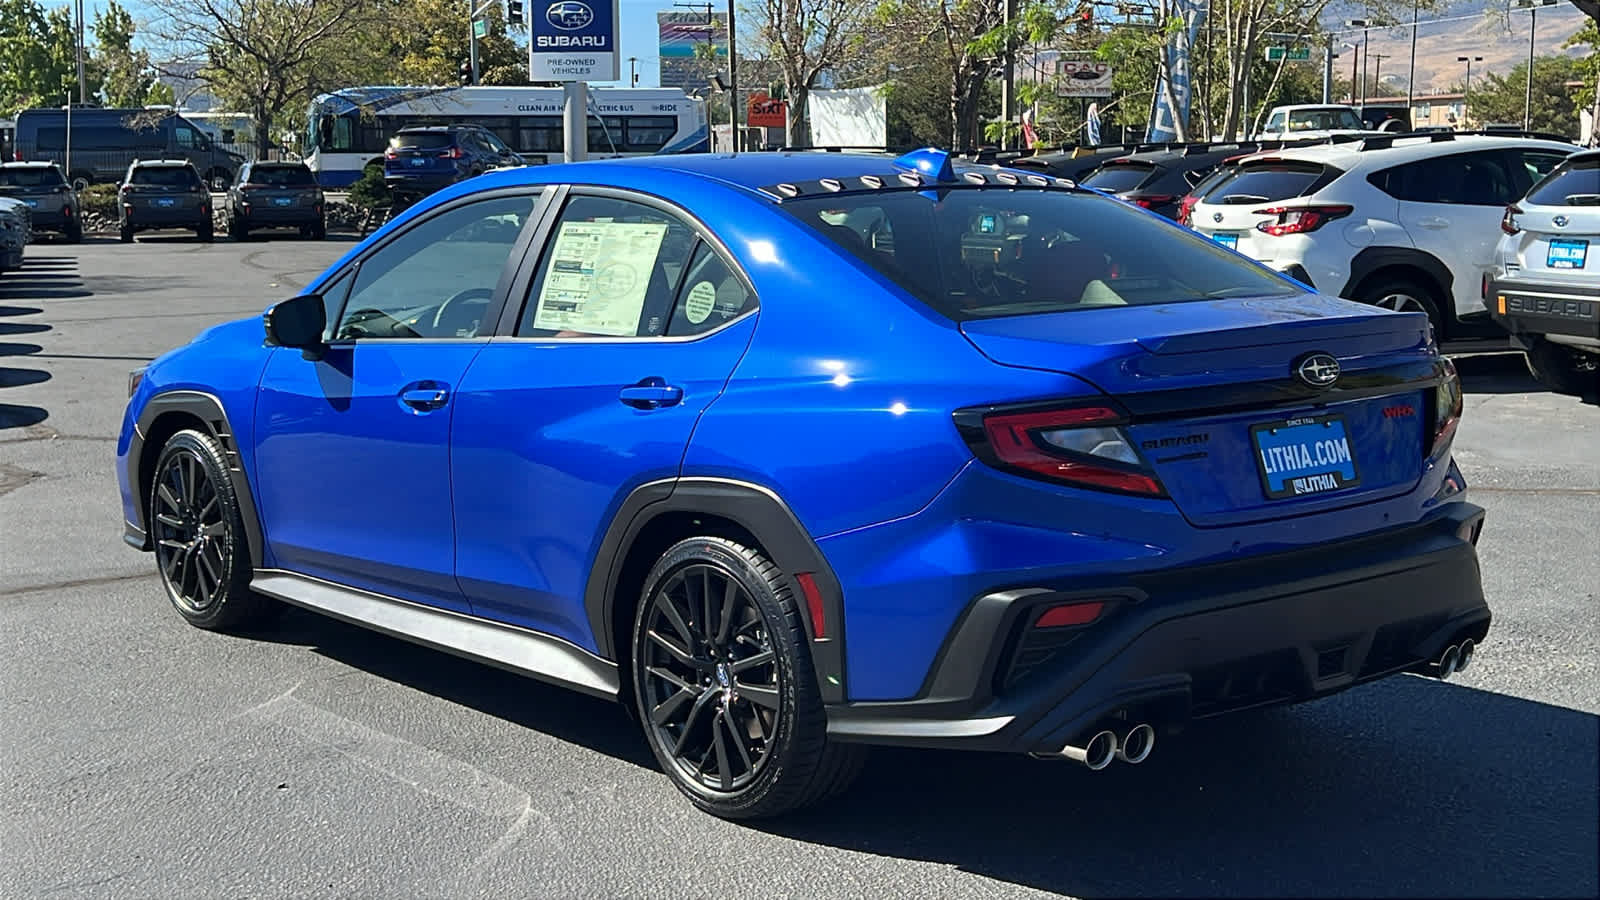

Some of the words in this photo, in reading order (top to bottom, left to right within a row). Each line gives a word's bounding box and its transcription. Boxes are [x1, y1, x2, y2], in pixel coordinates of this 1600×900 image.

[537, 35, 605, 47] SUBARU
[547, 58, 596, 66] PRE-OWNED
[552, 67, 591, 75] VEHICLES
[518, 104, 542, 112] CLEAN
[543, 104, 557, 112] AIR
[619, 104, 634, 112] BUS
[659, 104, 677, 112] RIDE
[1510, 298, 1593, 318] SUBARU
[1383, 406, 1416, 418] WRX
[1142, 433, 1209, 450] SUBARU
[1260, 437, 1352, 474] LITHIA.COM
[1303, 474, 1338, 493] LITHIA
